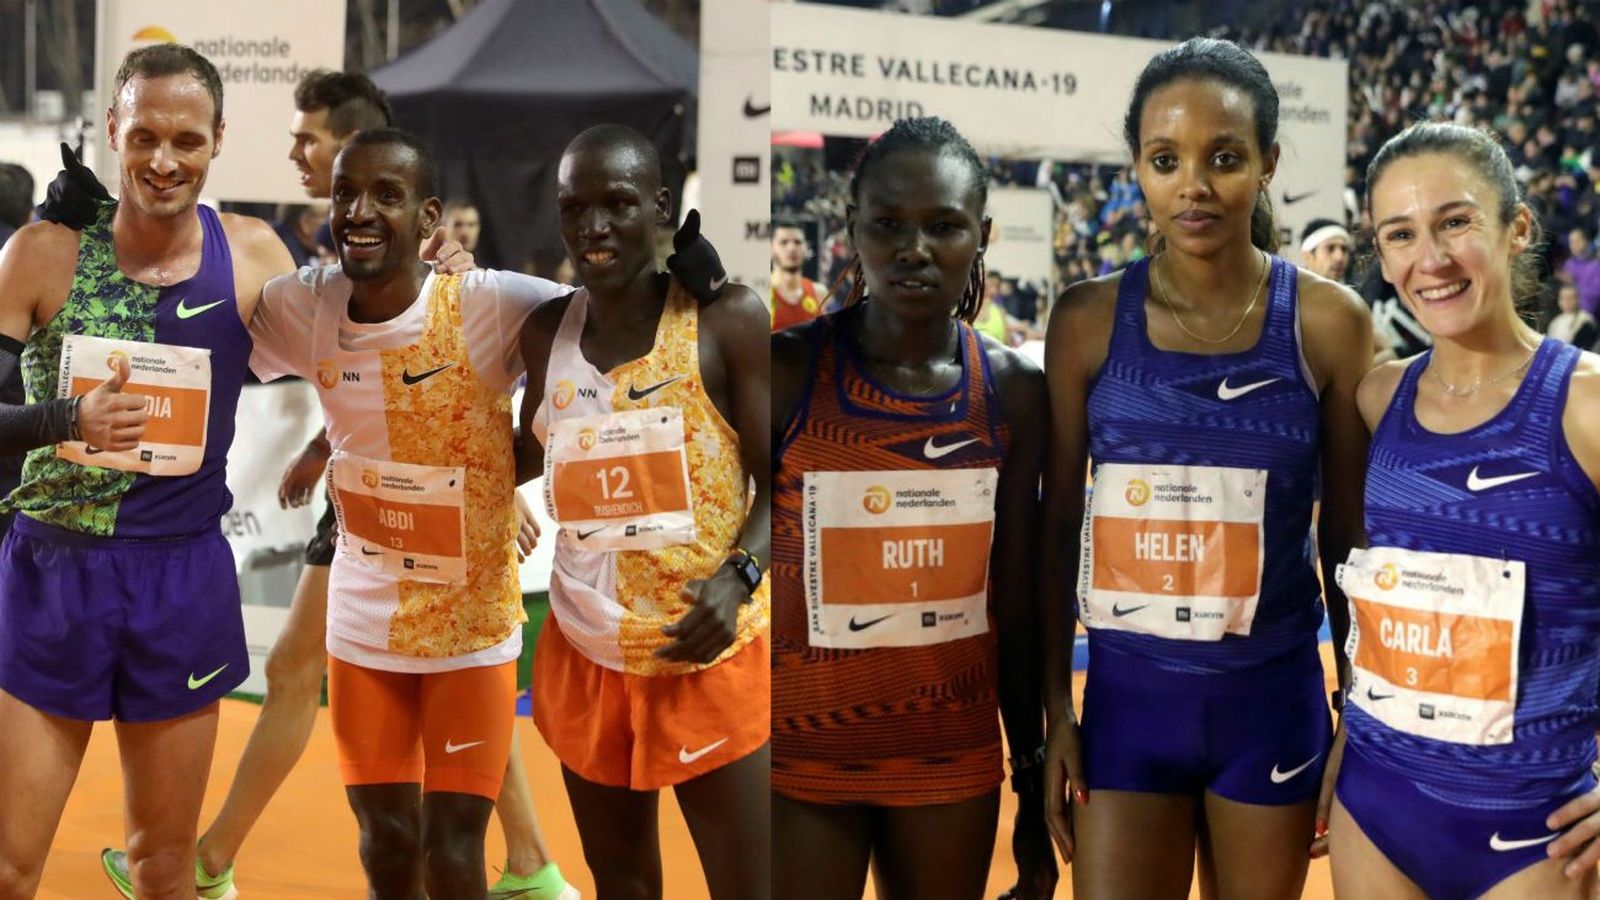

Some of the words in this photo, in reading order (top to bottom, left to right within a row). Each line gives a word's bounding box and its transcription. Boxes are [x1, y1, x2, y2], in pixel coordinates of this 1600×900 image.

[773, 48, 865, 77] ESTRE
[810, 95, 924, 121] MADRID
[132, 356, 166, 365] nationale
[131, 364, 177, 374] nederlanden
[342, 371, 360, 382] NN
[577, 388, 598, 398] NN
[381, 475, 413, 484] nationale
[596, 466, 634, 500] 12
[381, 483, 425, 492] nederlanden
[896, 488, 940, 498] nationale
[1154, 483, 1198, 493] nationale
[896, 498, 956, 508] nederlanden
[1154, 493, 1212, 504] nederlanden
[378, 507, 415, 531] ABDI
[389, 536, 404, 549] 13
[1135, 531, 1206, 562] HELEN
[882, 538, 944, 570] RUTH
[910, 581, 918, 598] 1
[1162, 574, 1175, 592] 2
[1401, 580, 1464, 596] nederlanden
[1379, 617, 1454, 659] CARLA
[1405, 667, 1418, 685] 3
